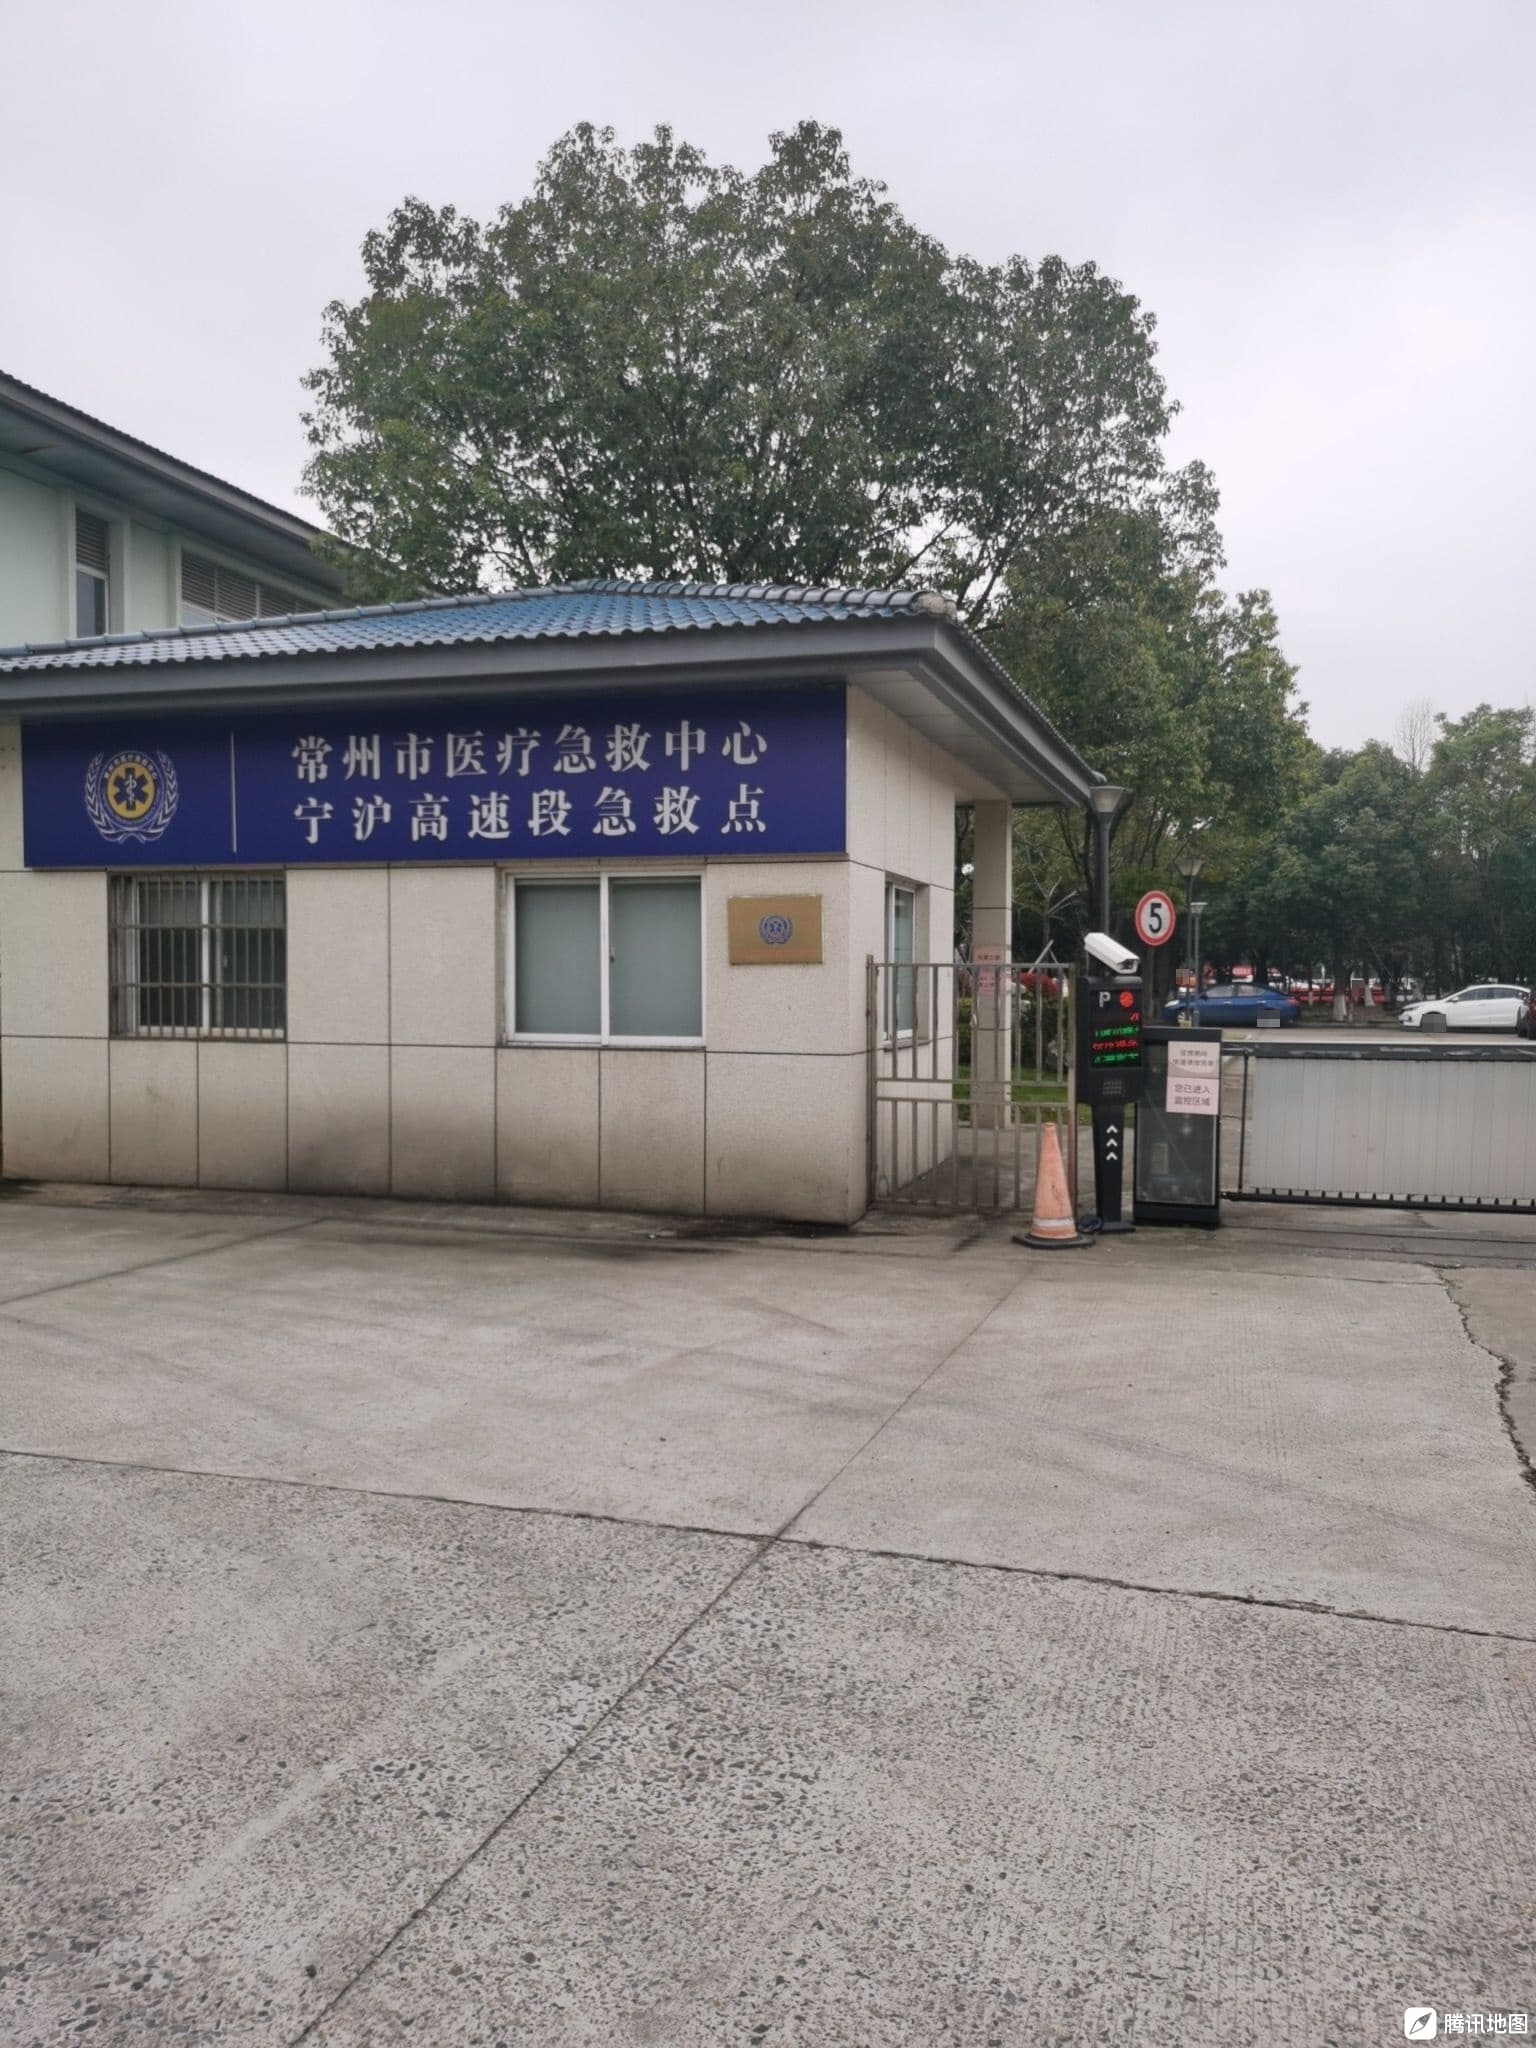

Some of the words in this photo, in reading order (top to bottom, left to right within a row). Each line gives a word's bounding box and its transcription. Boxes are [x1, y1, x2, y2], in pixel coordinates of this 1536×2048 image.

[291, 720, 768, 784] 常州市医疗急救中心
[293, 783, 767, 845] 宁沪高速段急救点
[1149, 902, 1162, 934] 5
[1099, 991, 1111, 1008] P
